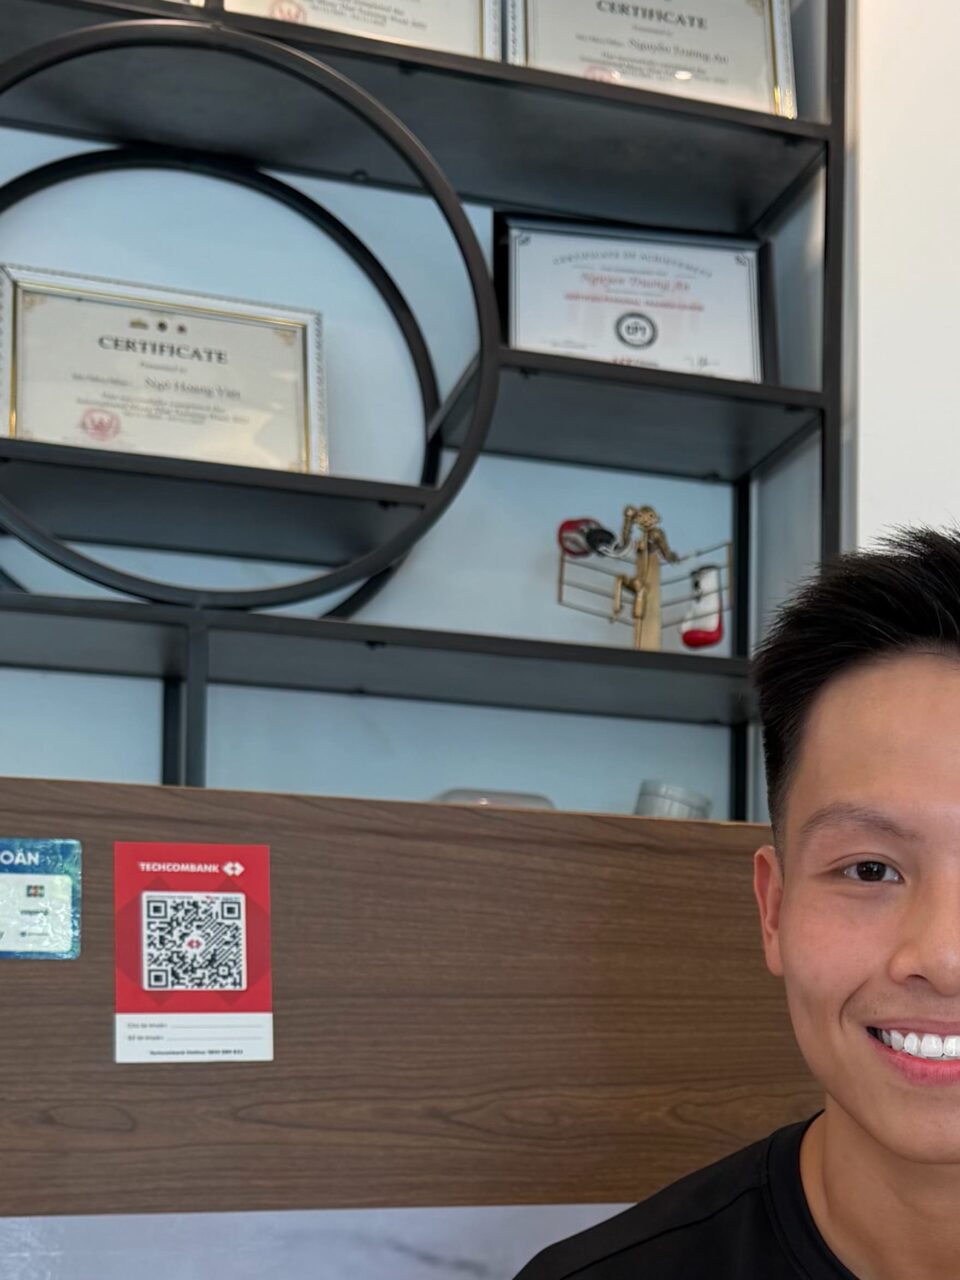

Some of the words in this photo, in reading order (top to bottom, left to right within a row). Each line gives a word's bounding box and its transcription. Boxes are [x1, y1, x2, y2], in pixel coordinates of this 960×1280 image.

[597, 1, 708, 30] CERTIFICATE
[98, 335, 229, 365] CERTIFICATE
[138, 861, 220, 874] TECHCOMBANK
